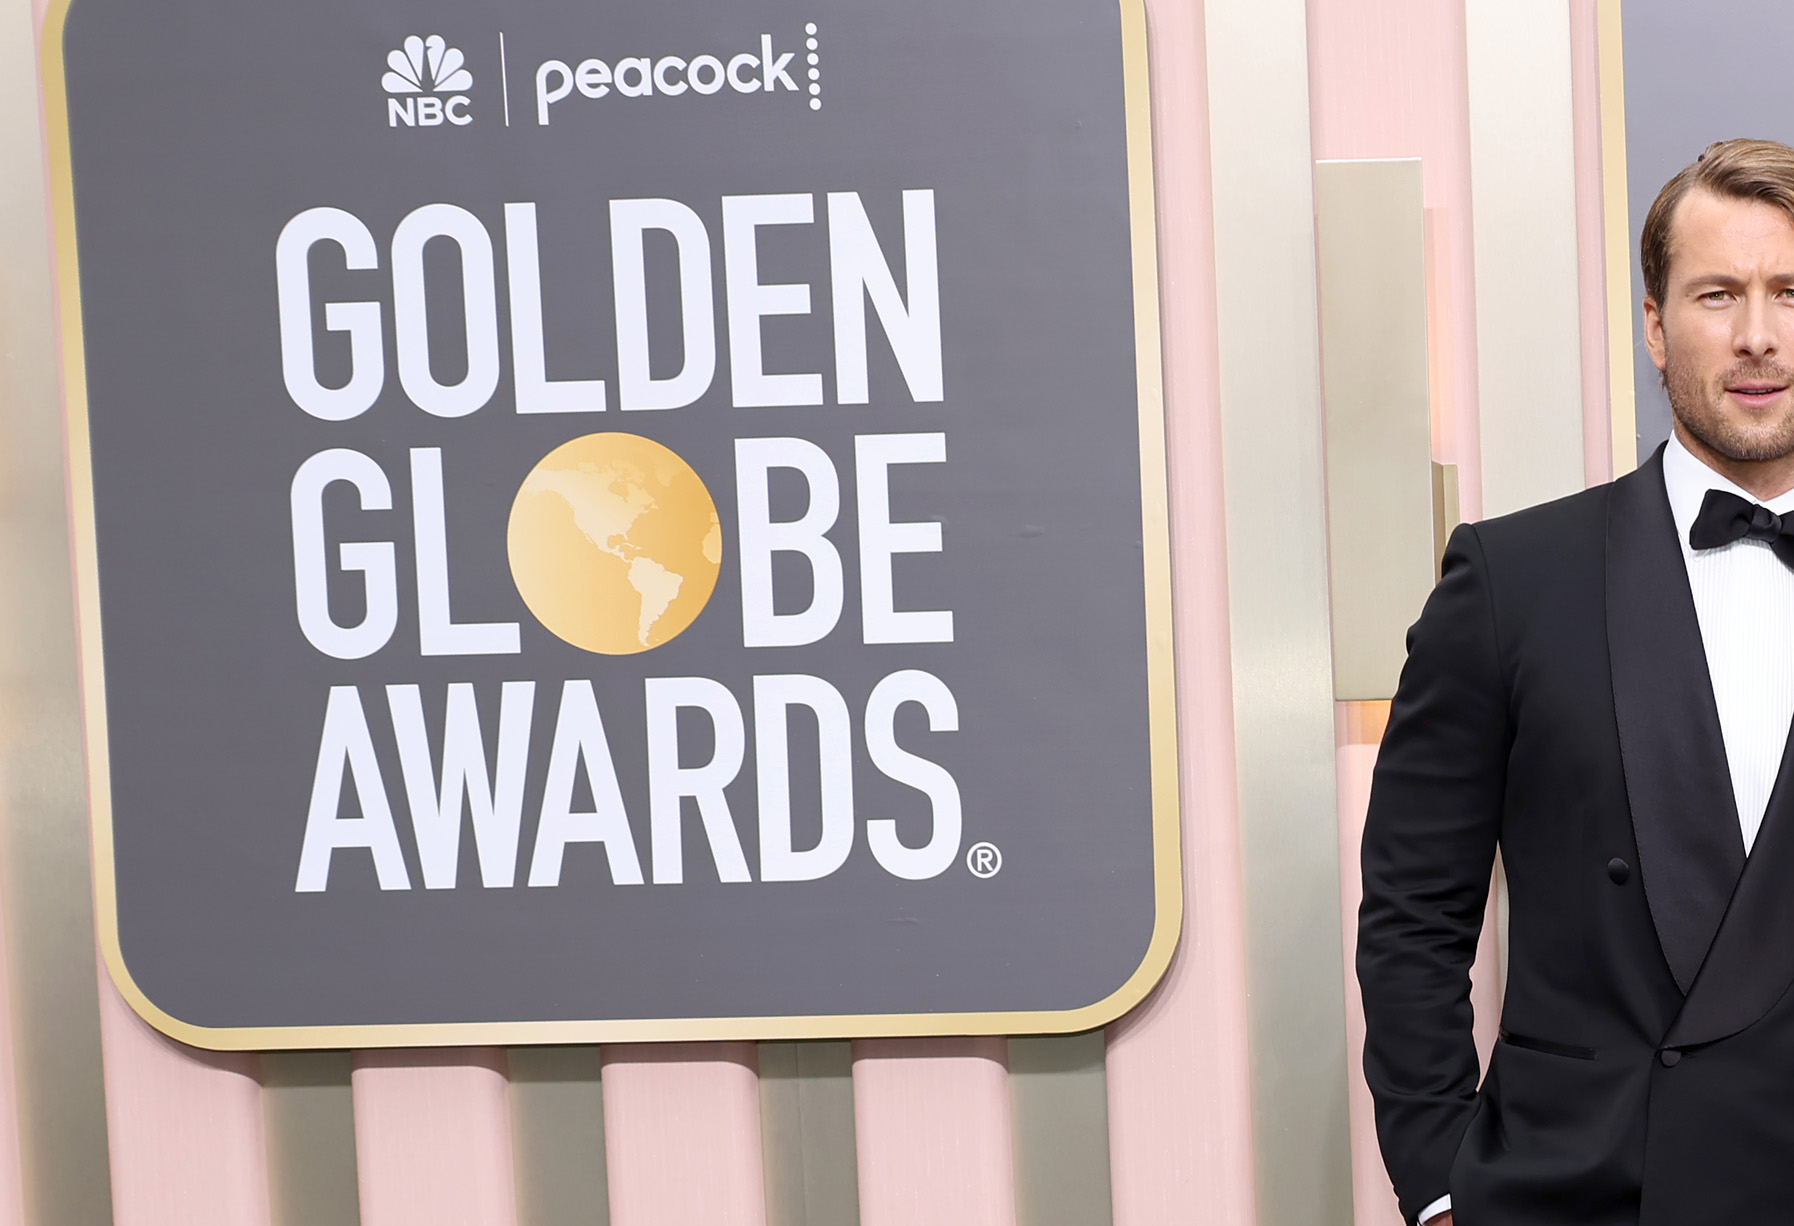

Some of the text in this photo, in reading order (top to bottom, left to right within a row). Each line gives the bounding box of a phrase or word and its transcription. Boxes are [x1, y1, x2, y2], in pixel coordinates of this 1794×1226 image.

[387, 95, 474, 128] NBC
[535, 33, 801, 127] peacock
[275, 188, 945, 421] GOLDEN
[289, 431, 955, 661] GLOBE
